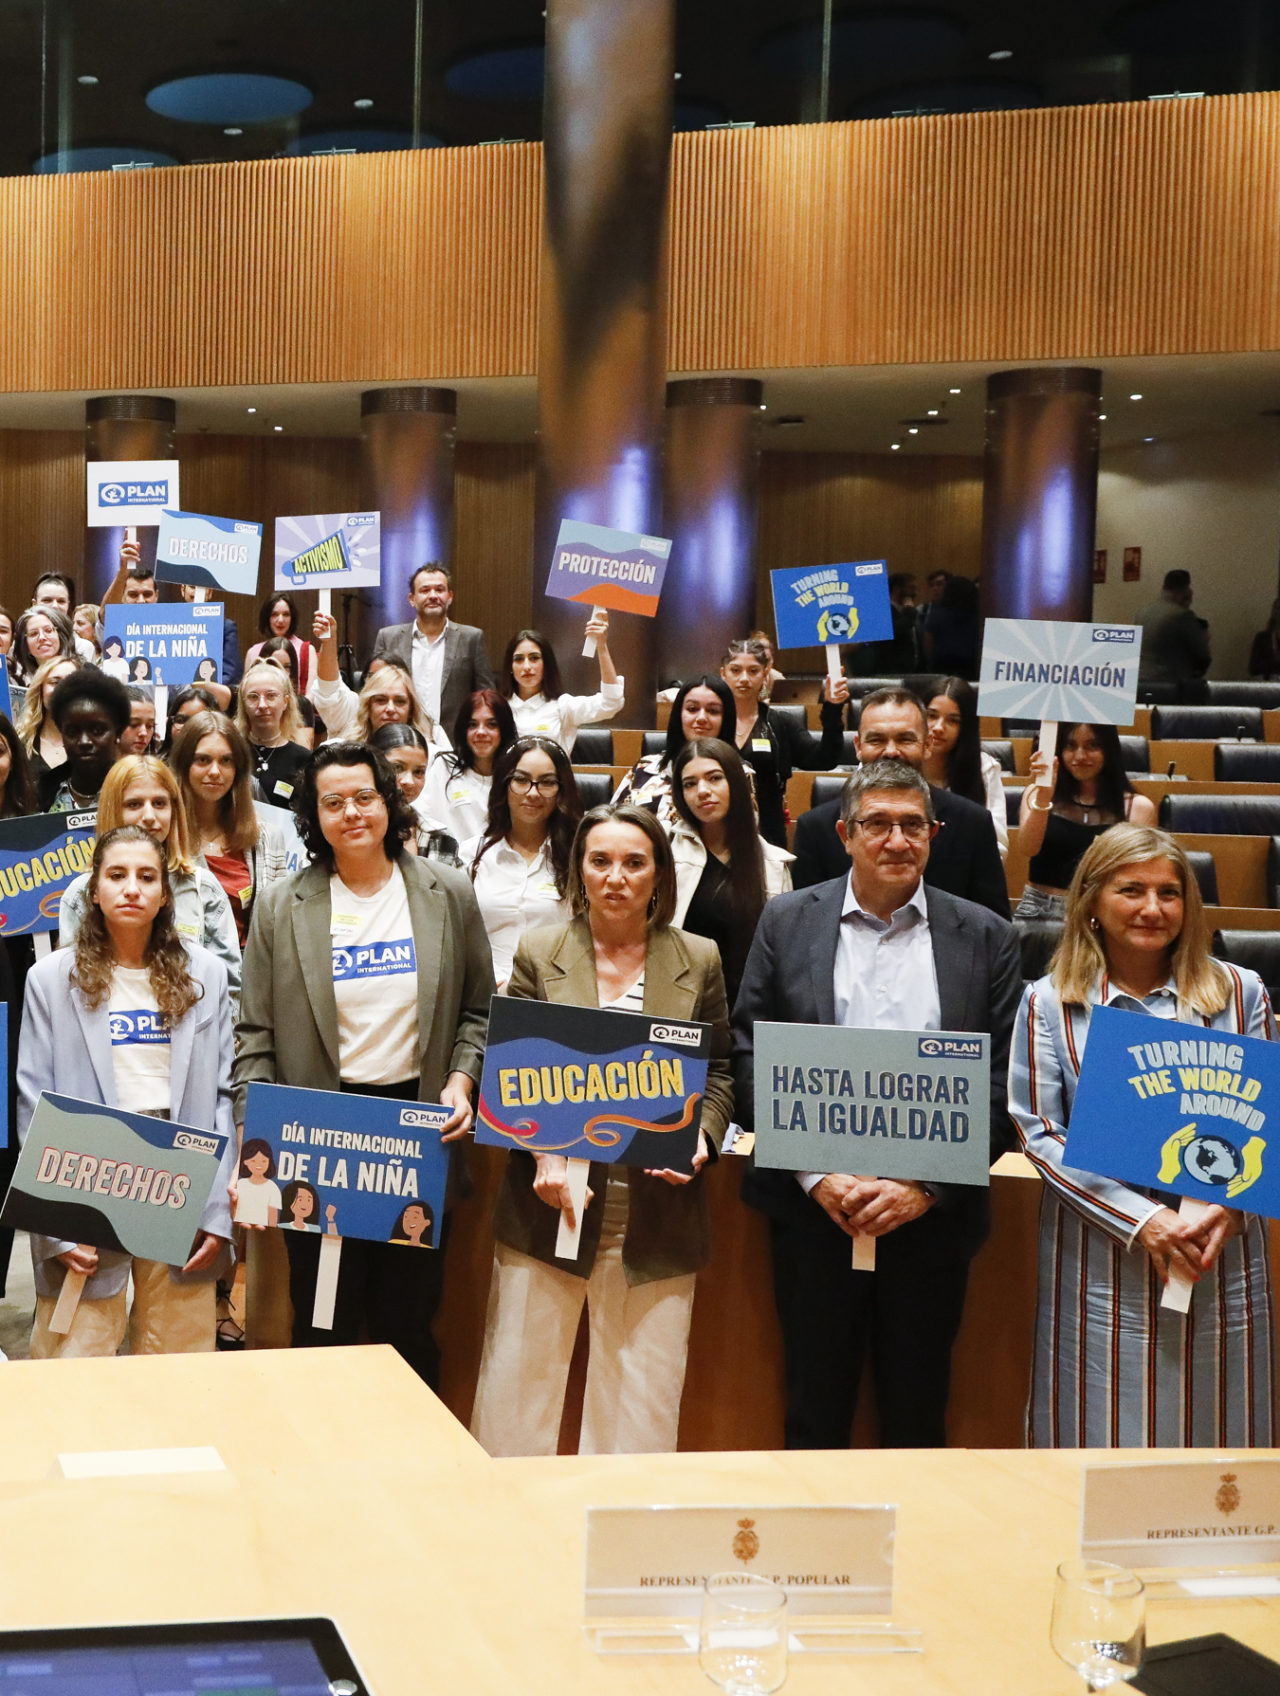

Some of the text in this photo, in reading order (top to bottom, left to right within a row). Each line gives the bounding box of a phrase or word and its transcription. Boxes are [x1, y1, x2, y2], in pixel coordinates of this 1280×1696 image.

[127, 484, 166, 497] PLAN
[169, 537, 249, 564] DERECHOS
[294, 535, 343, 574] ACTIVISMO
[558, 551, 657, 584] PROTECCIÓN
[790, 569, 839, 595] TURNING
[794, 590, 816, 608] THE
[126, 621, 209, 636] DÍA INTERNACIONAL
[125, 636, 208, 658] DE LA NIÑA
[994, 661, 1126, 688] FINANCIACIÓN
[356, 945, 411, 965] PLAN
[357, 962, 412, 974] INTERNATIONAL
[671, 1029, 699, 1040] PLAN
[944, 1042, 980, 1053] PLAN
[1127, 1040, 1244, 1071] TURNING
[498, 1050, 685, 1107] EDUCACIÓN
[772, 1064, 970, 1105] HASTA LOGRAR
[1127, 1067, 1262, 1102] THE WORLD
[420, 1113, 446, 1124] PLAN
[772, 1098, 970, 1144] LA IGUALDAD
[1179, 1092, 1266, 1132] AROUND
[192, 1138, 216, 1149] PLAN
[281, 1121, 423, 1159] DÍA INTERNACIONAL
[36, 1146, 192, 1210] DERECHOS
[277, 1151, 420, 1199] DE LA NIÑA
[1147, 1525, 1252, 1539] REPRESENTANTE
[787, 1575, 851, 1585] POPULAR
